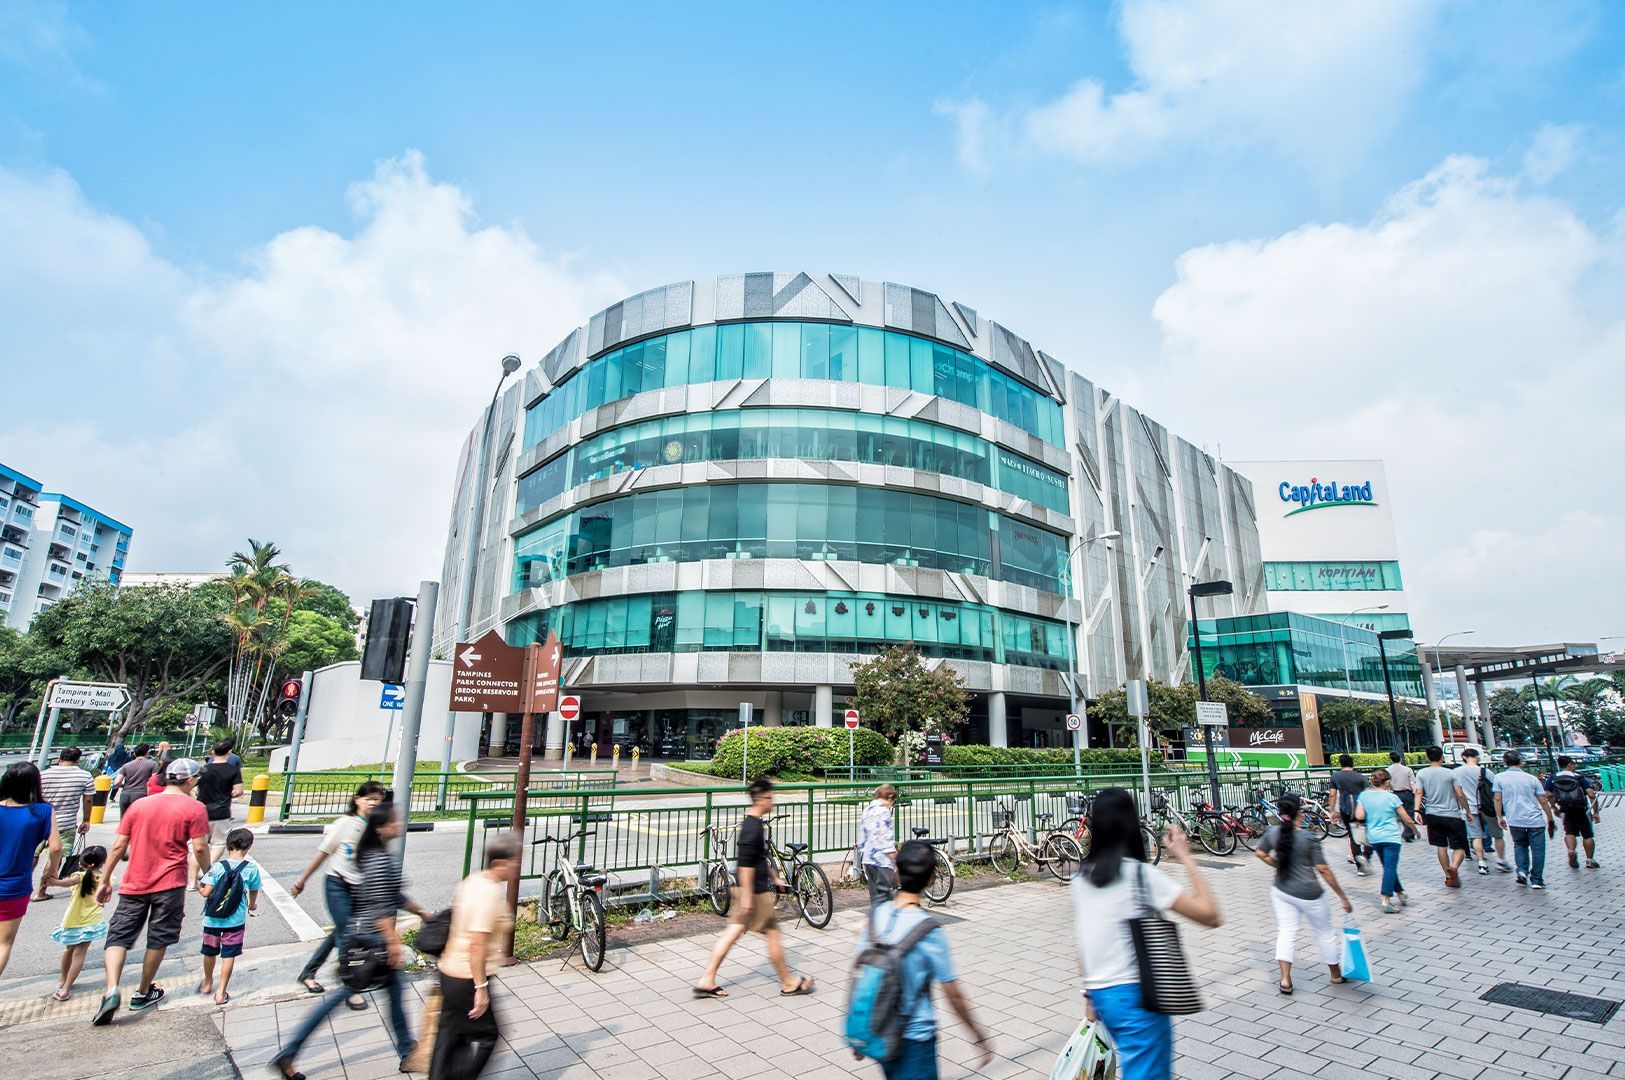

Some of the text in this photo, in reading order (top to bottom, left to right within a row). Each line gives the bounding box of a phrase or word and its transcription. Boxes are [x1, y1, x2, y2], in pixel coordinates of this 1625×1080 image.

[1279, 477, 1373, 506] CapitaLand
[1318, 568, 1376, 578] KOPITIAM
[655, 615, 673, 625] Pizza
[657, 621, 672, 630] Hut
[457, 670, 492, 678] TAMPINES
[476, 680, 518, 688] CONNECTOR
[58, 687, 92, 697] Tampines
[55, 696, 115, 708] Century Square
